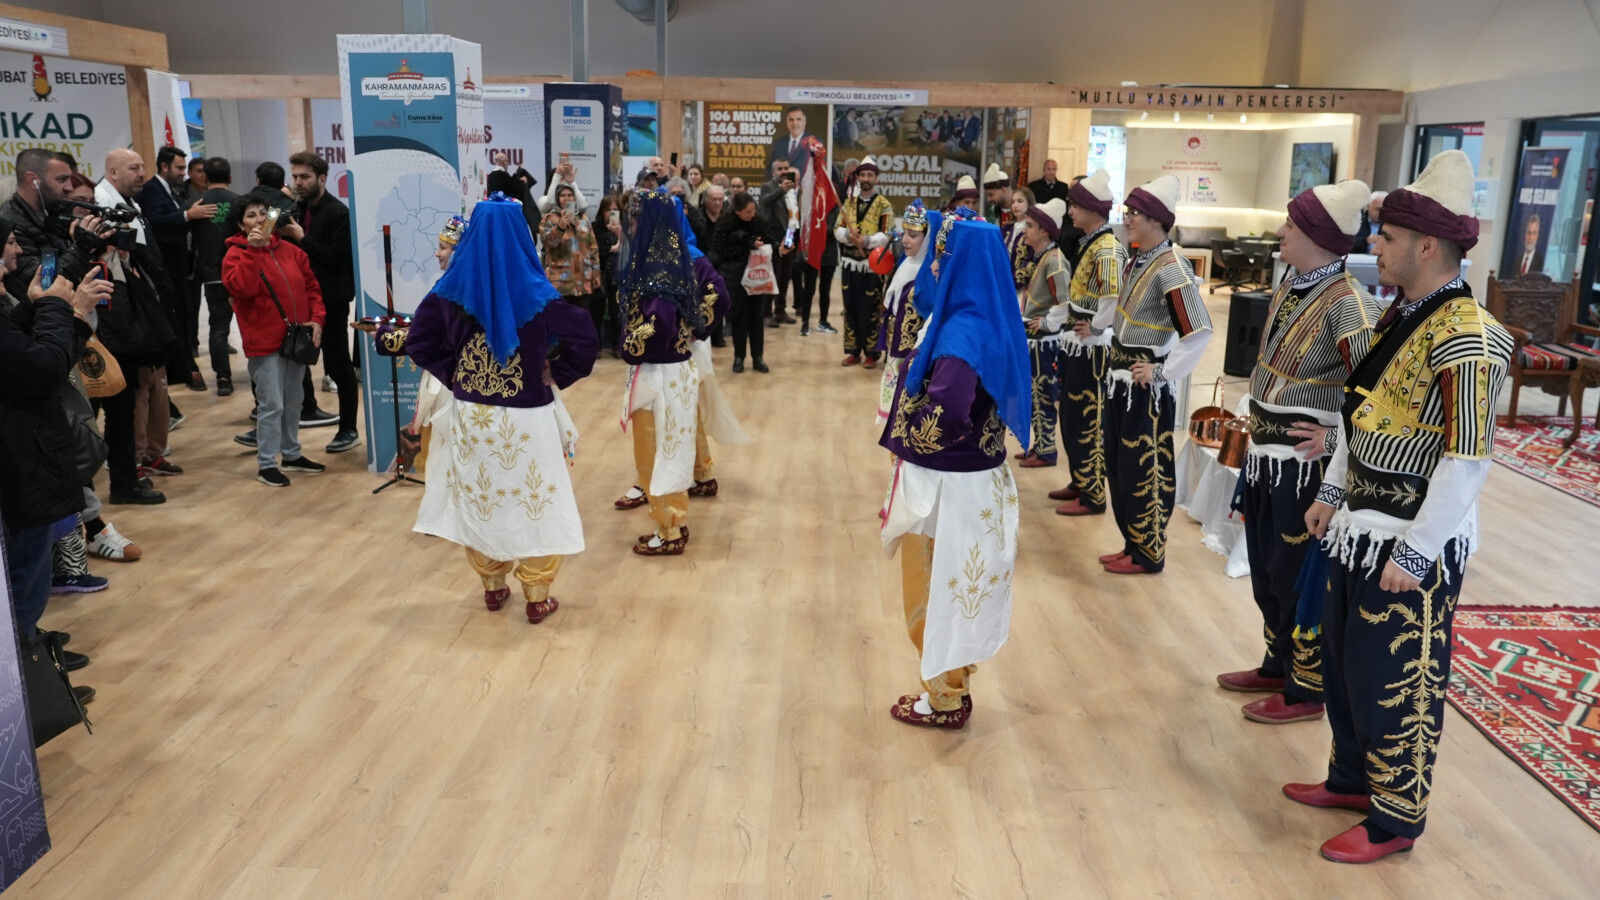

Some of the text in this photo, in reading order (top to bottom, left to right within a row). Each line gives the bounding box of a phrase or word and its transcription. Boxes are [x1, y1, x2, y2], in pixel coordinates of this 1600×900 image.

[811, 91, 897, 100] TÜRKOĞLU BELEDİYESİ
[1147, 92, 1224, 108] YAŞAMIN
[709, 111, 731, 122] 106
[709, 122, 737, 134] 346
[709, 144, 766, 157] 2 YILDA
[879, 173, 941, 184] RUMLULUK
